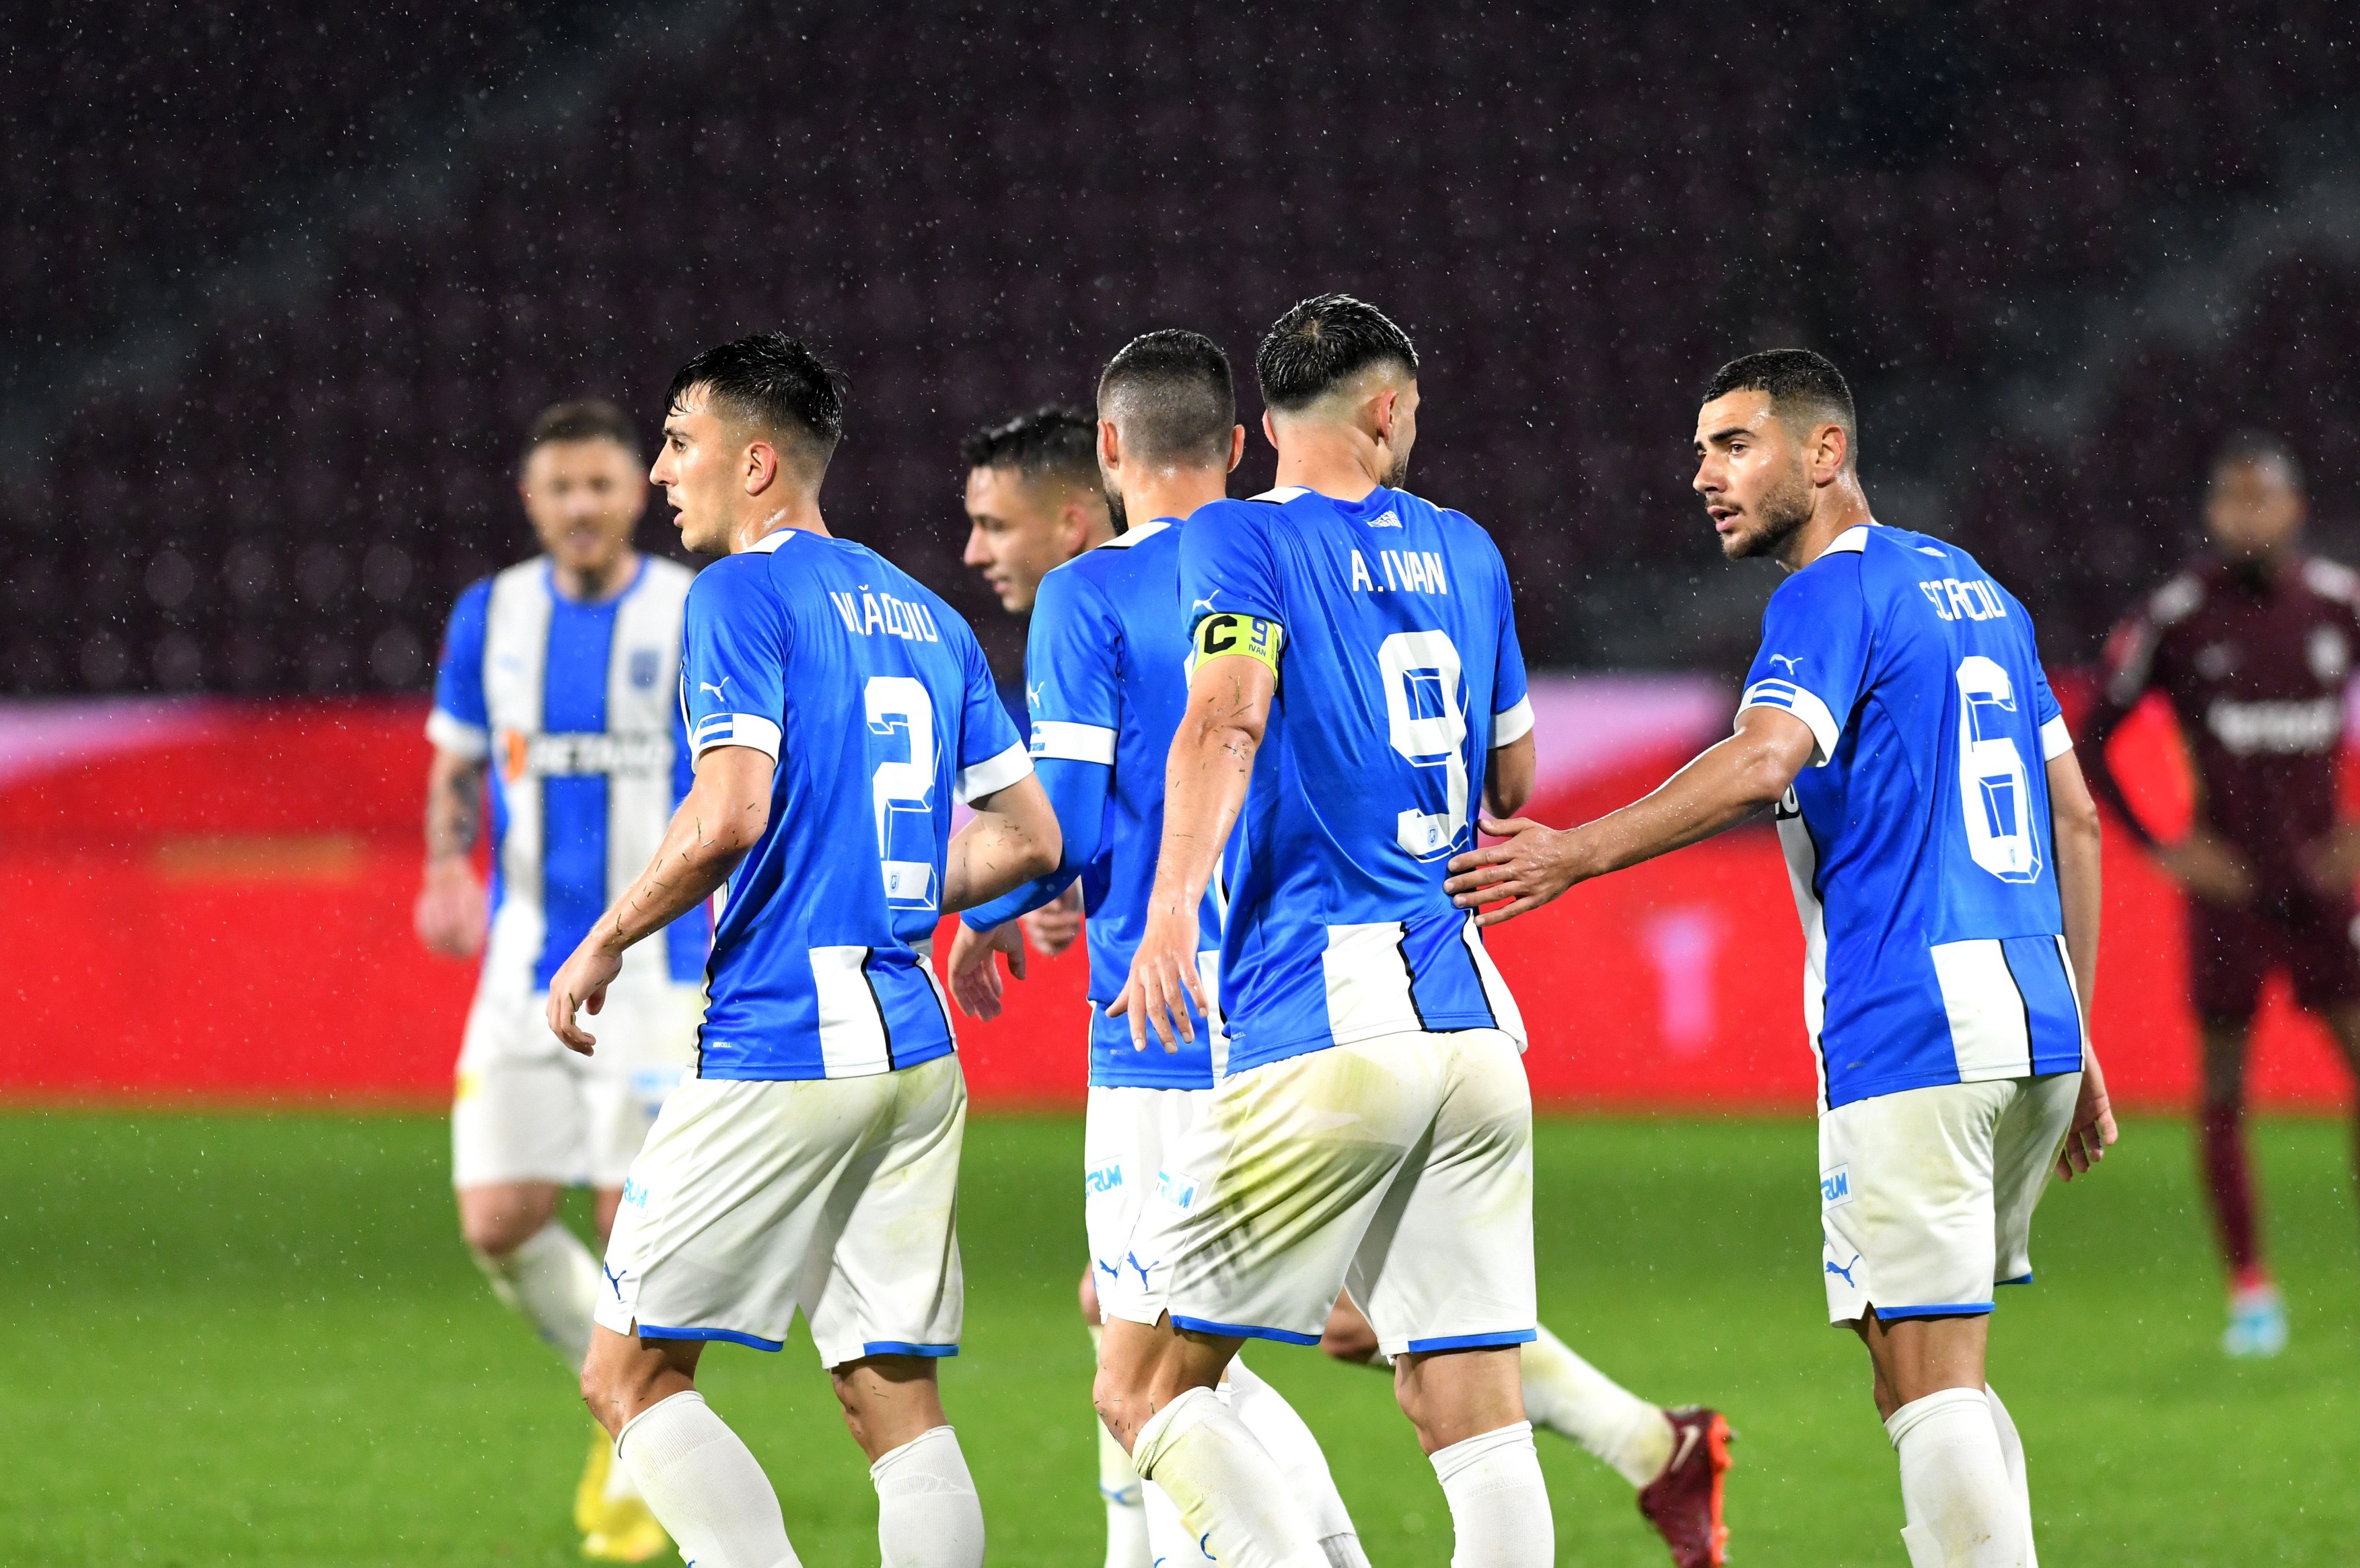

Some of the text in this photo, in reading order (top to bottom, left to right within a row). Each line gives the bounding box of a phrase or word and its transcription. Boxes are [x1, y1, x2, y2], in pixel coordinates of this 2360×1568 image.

[1204, 614, 1238, 655] C
[1248, 643, 1266, 657] IVAN
[1251, 617, 1268, 647] 9
[865, 676, 942, 911] 2
[1377, 630, 1470, 863] 9
[1955, 655, 2043, 884] 6
